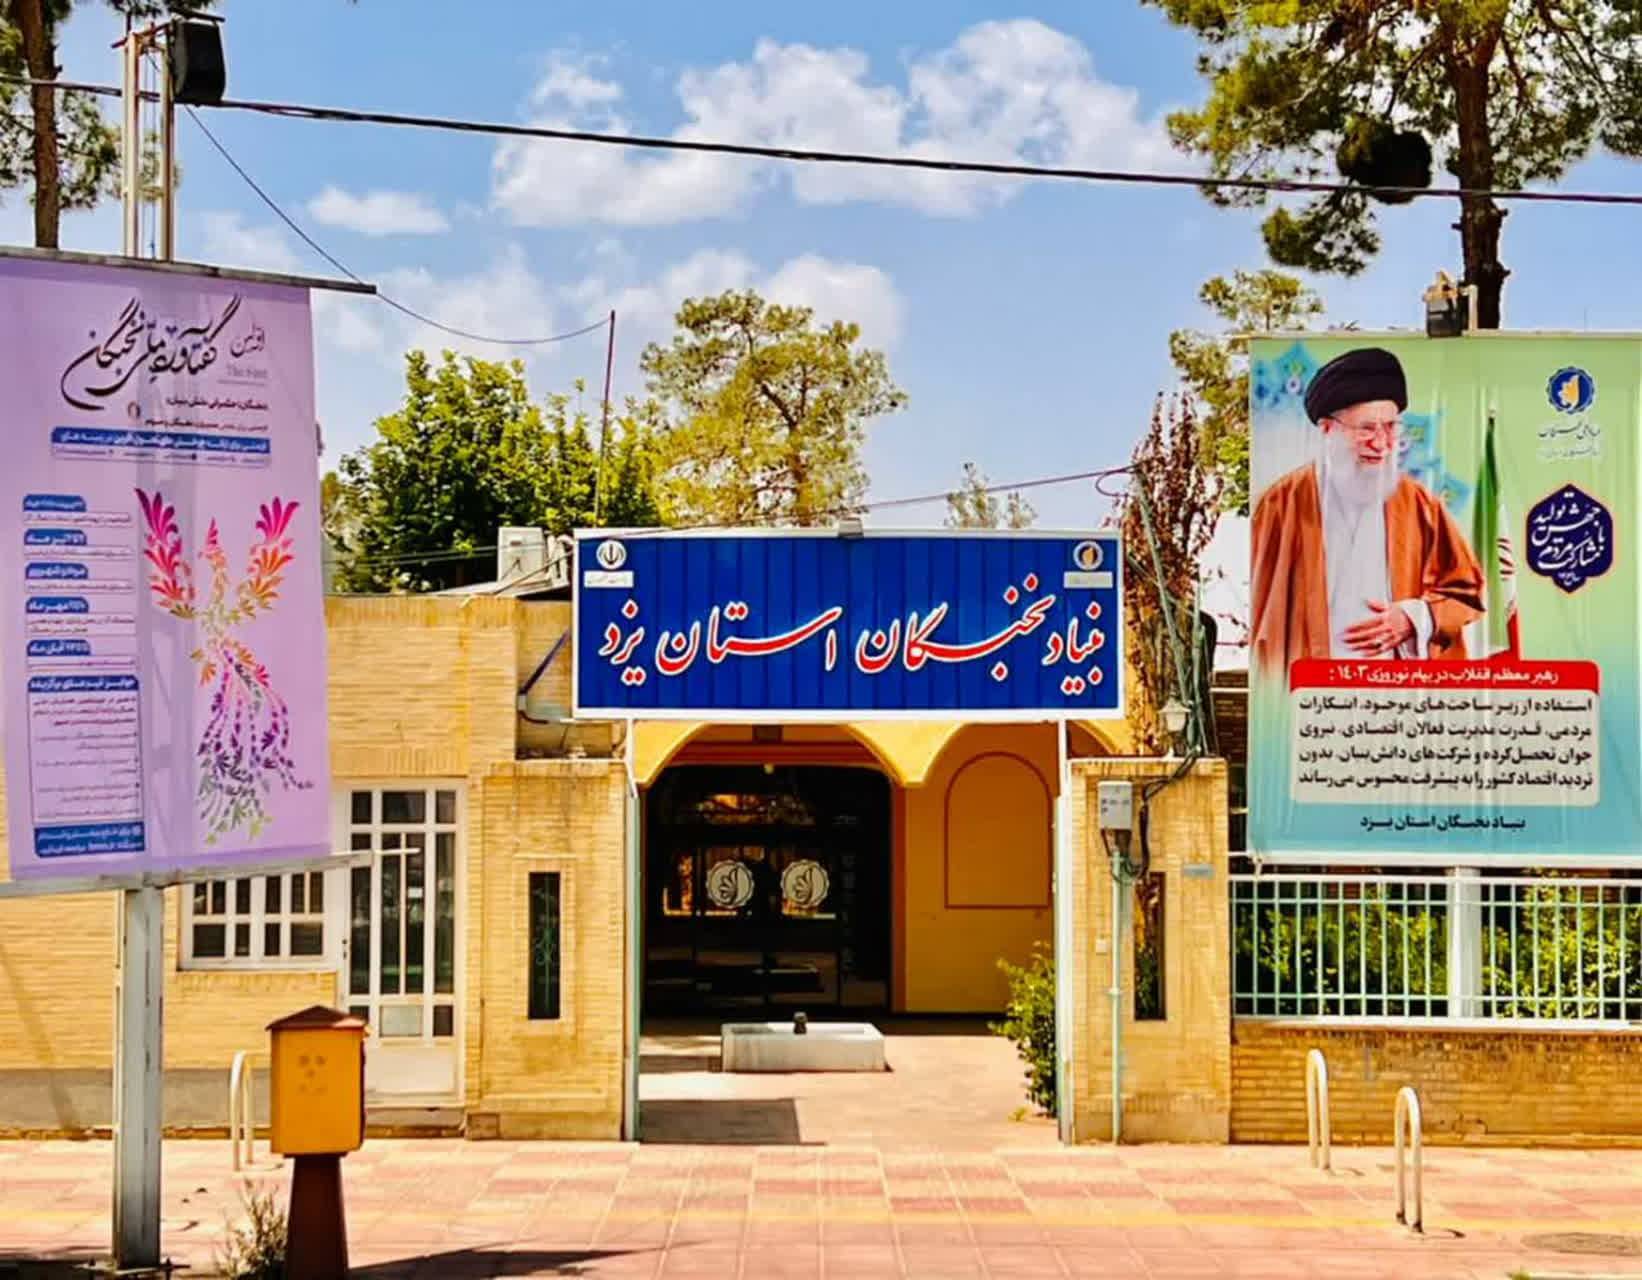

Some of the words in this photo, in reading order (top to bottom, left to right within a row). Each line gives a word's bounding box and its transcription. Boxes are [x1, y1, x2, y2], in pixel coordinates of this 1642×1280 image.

[598, 599, 645, 686] یزد
[654, 601, 843, 675] استان
[855, 573, 1057, 681] نخبگان
[1041, 601, 1106, 695] بنیاد
[1449, 667, 1491, 685] انقلاب
[1492, 667, 1530, 685] معظم
[1530, 668, 1559, 685] رهبر
